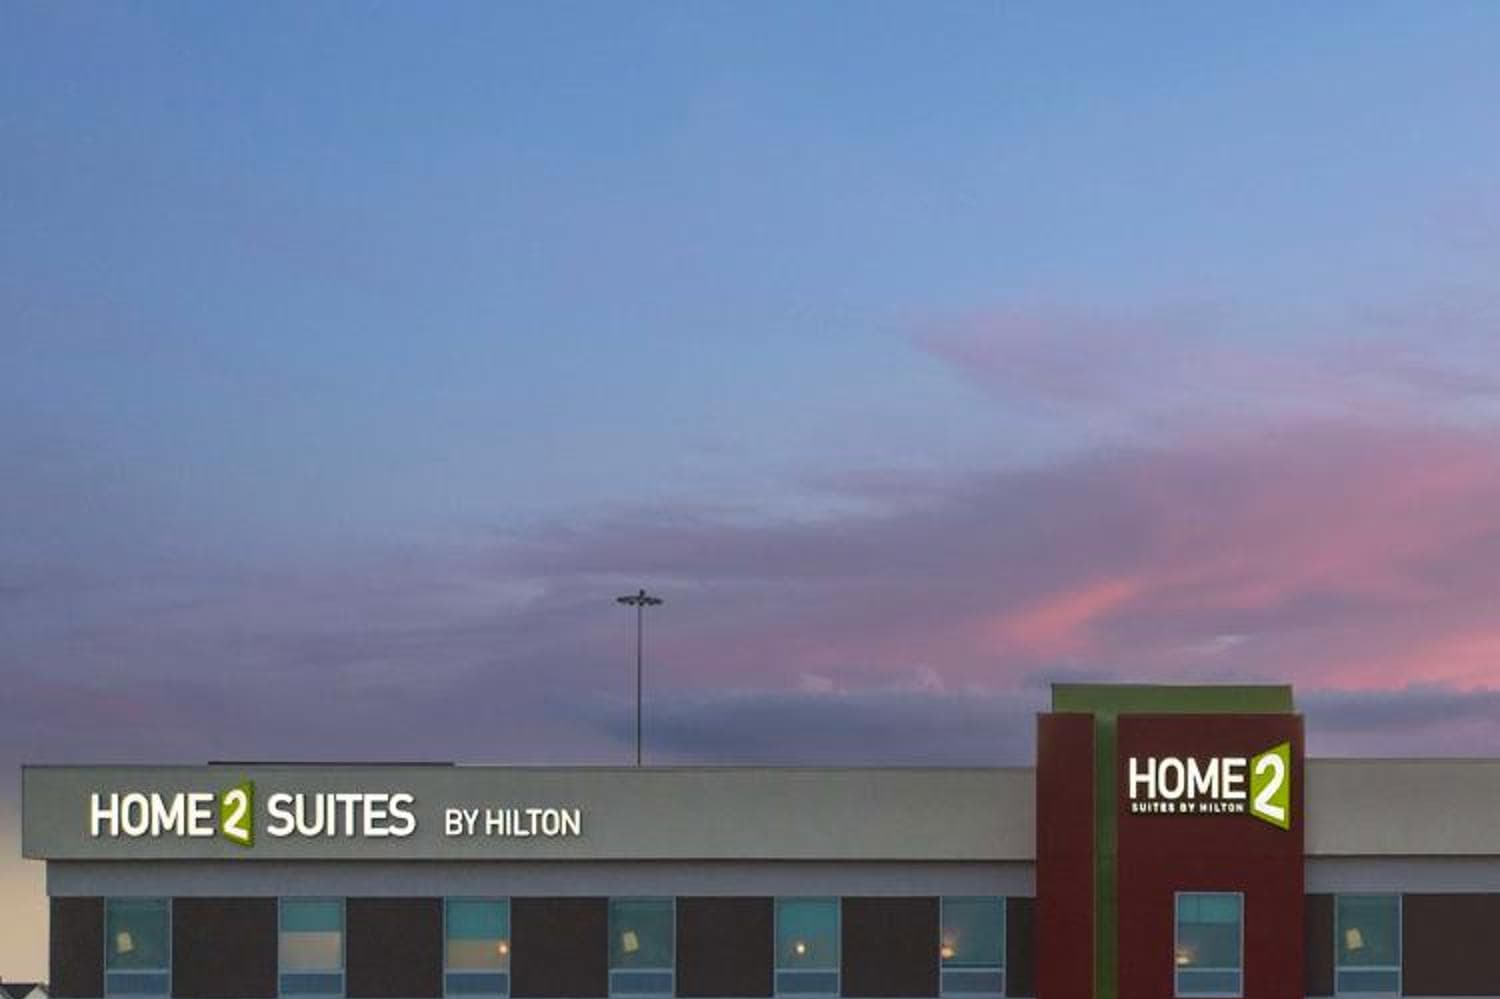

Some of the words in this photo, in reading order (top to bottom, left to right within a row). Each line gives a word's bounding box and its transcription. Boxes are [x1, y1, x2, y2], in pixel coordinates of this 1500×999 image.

[1129, 757, 1247, 799] HOME
[1255, 753, 1285, 821] 2
[1131, 802, 1175, 813] SUITES
[1180, 802, 1195, 813] BY
[1199, 802, 1244, 813] HILTON
[90, 792, 214, 836] HOME
[222, 788, 249, 840] 2
[267, 792, 417, 836] SUITES
[445, 808, 479, 836] BY
[485, 808, 581, 836] HILTON
